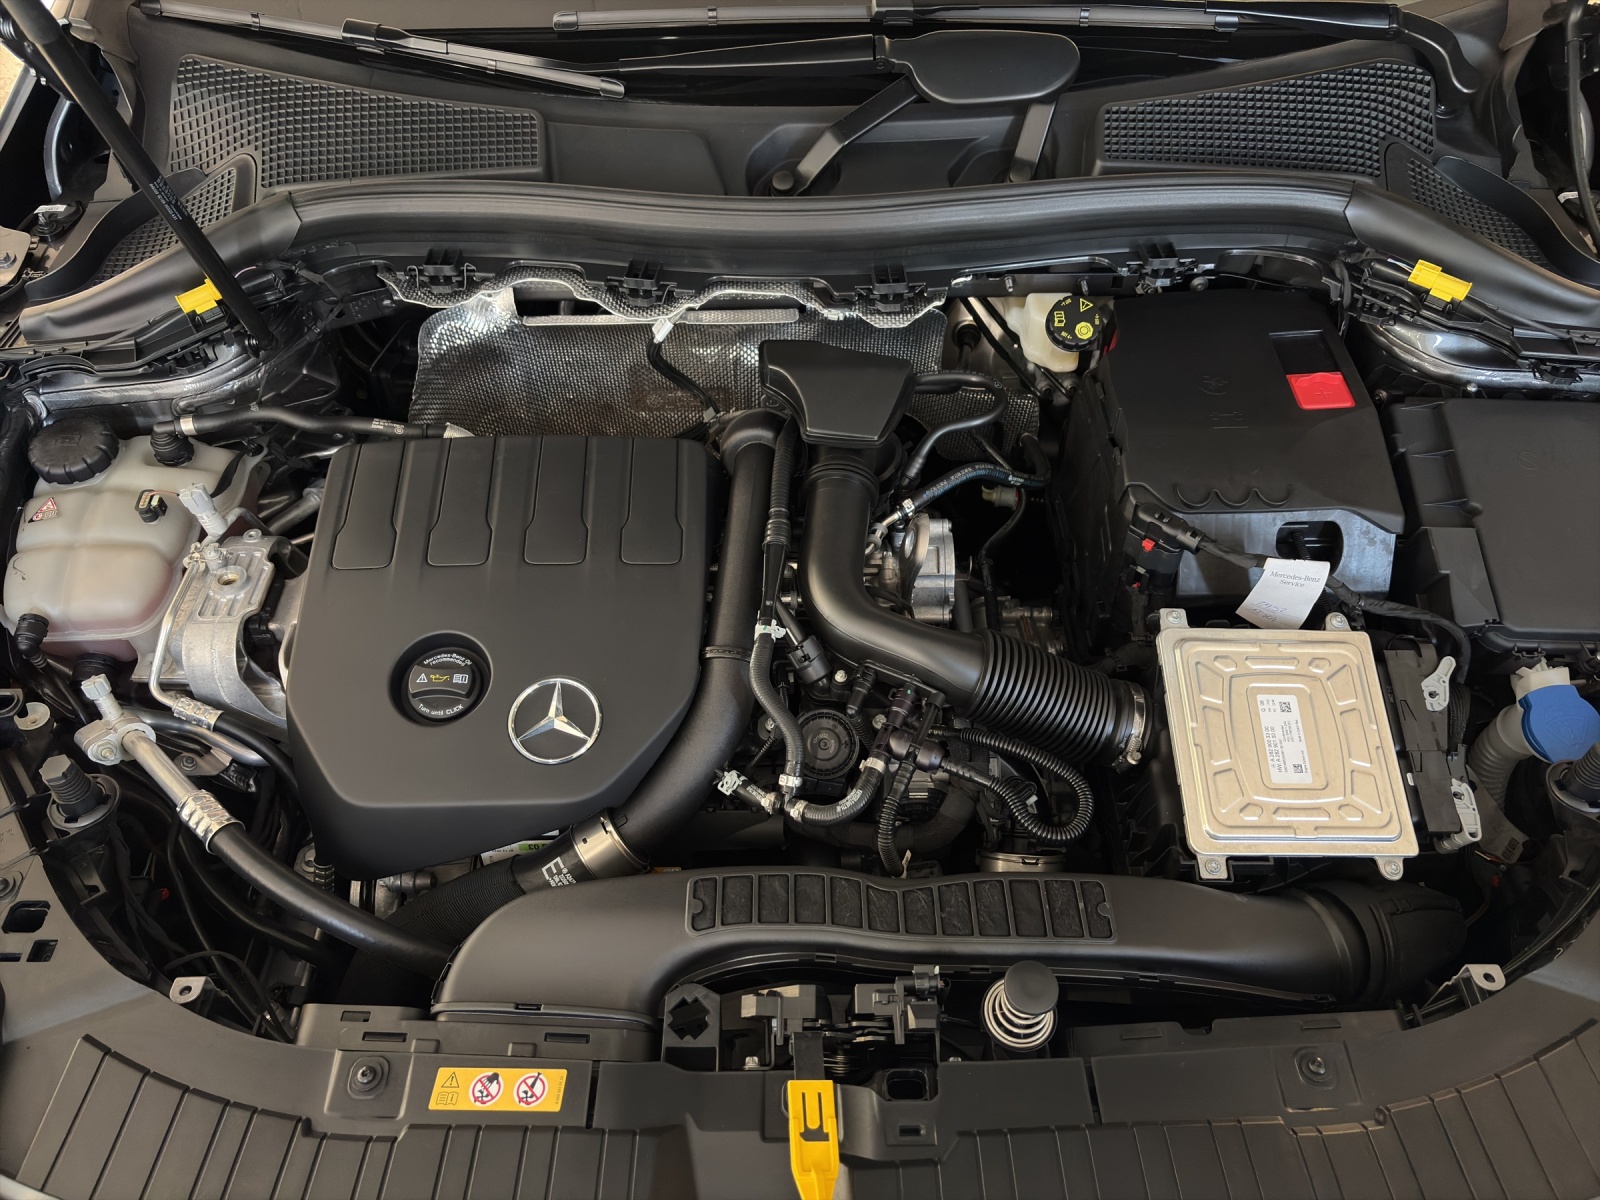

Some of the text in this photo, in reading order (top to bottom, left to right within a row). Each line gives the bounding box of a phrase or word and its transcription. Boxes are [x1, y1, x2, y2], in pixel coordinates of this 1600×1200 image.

[1270, 570, 1320, 582] Mercedes-Benz
[1280, 579, 1304, 588] Service
[424, 653, 466, 665] Mercedes-Benz
[430, 658, 466, 666] recommended
[418, 704, 430, 713] Turn
[446, 704, 464, 715] CLICK
